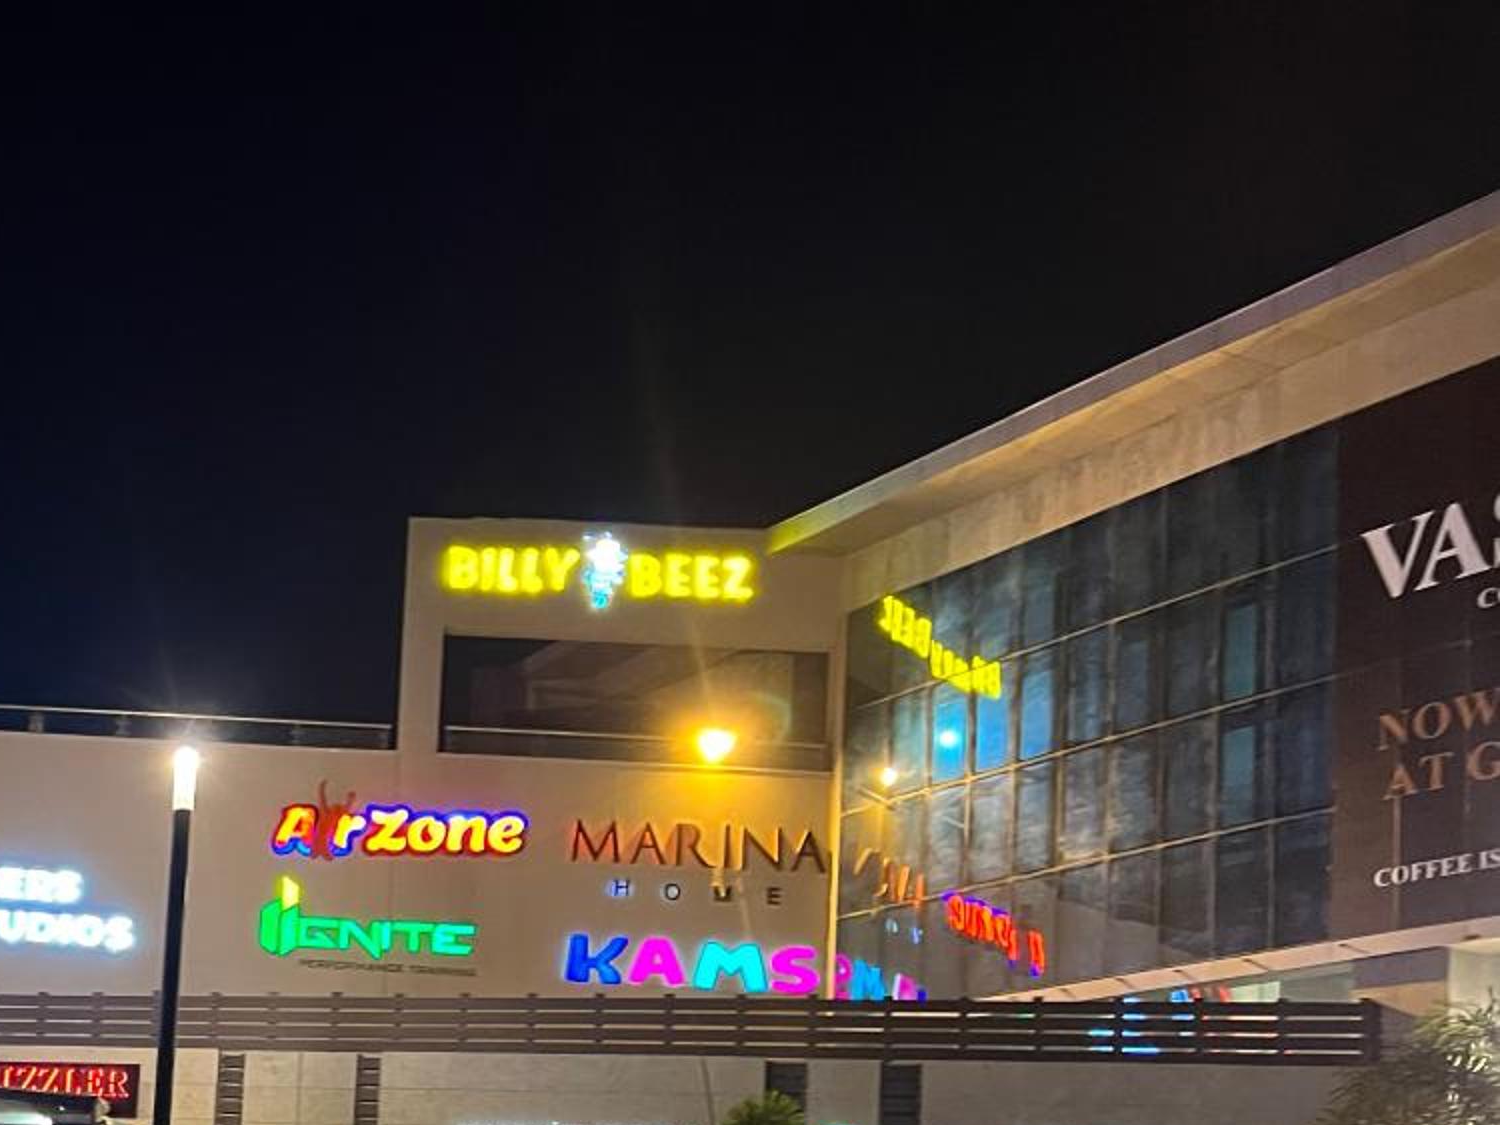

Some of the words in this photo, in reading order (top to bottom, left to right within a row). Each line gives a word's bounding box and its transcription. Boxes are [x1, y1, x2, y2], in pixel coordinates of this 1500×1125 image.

[446, 544, 581, 594] BILLY
[629, 551, 755, 602] BEEZ
[1382, 751, 1454, 800] AT
[570, 819, 827, 874] MARINA
[1373, 853, 1474, 888] COFFEE
[611, 879, 782, 905] HOME
